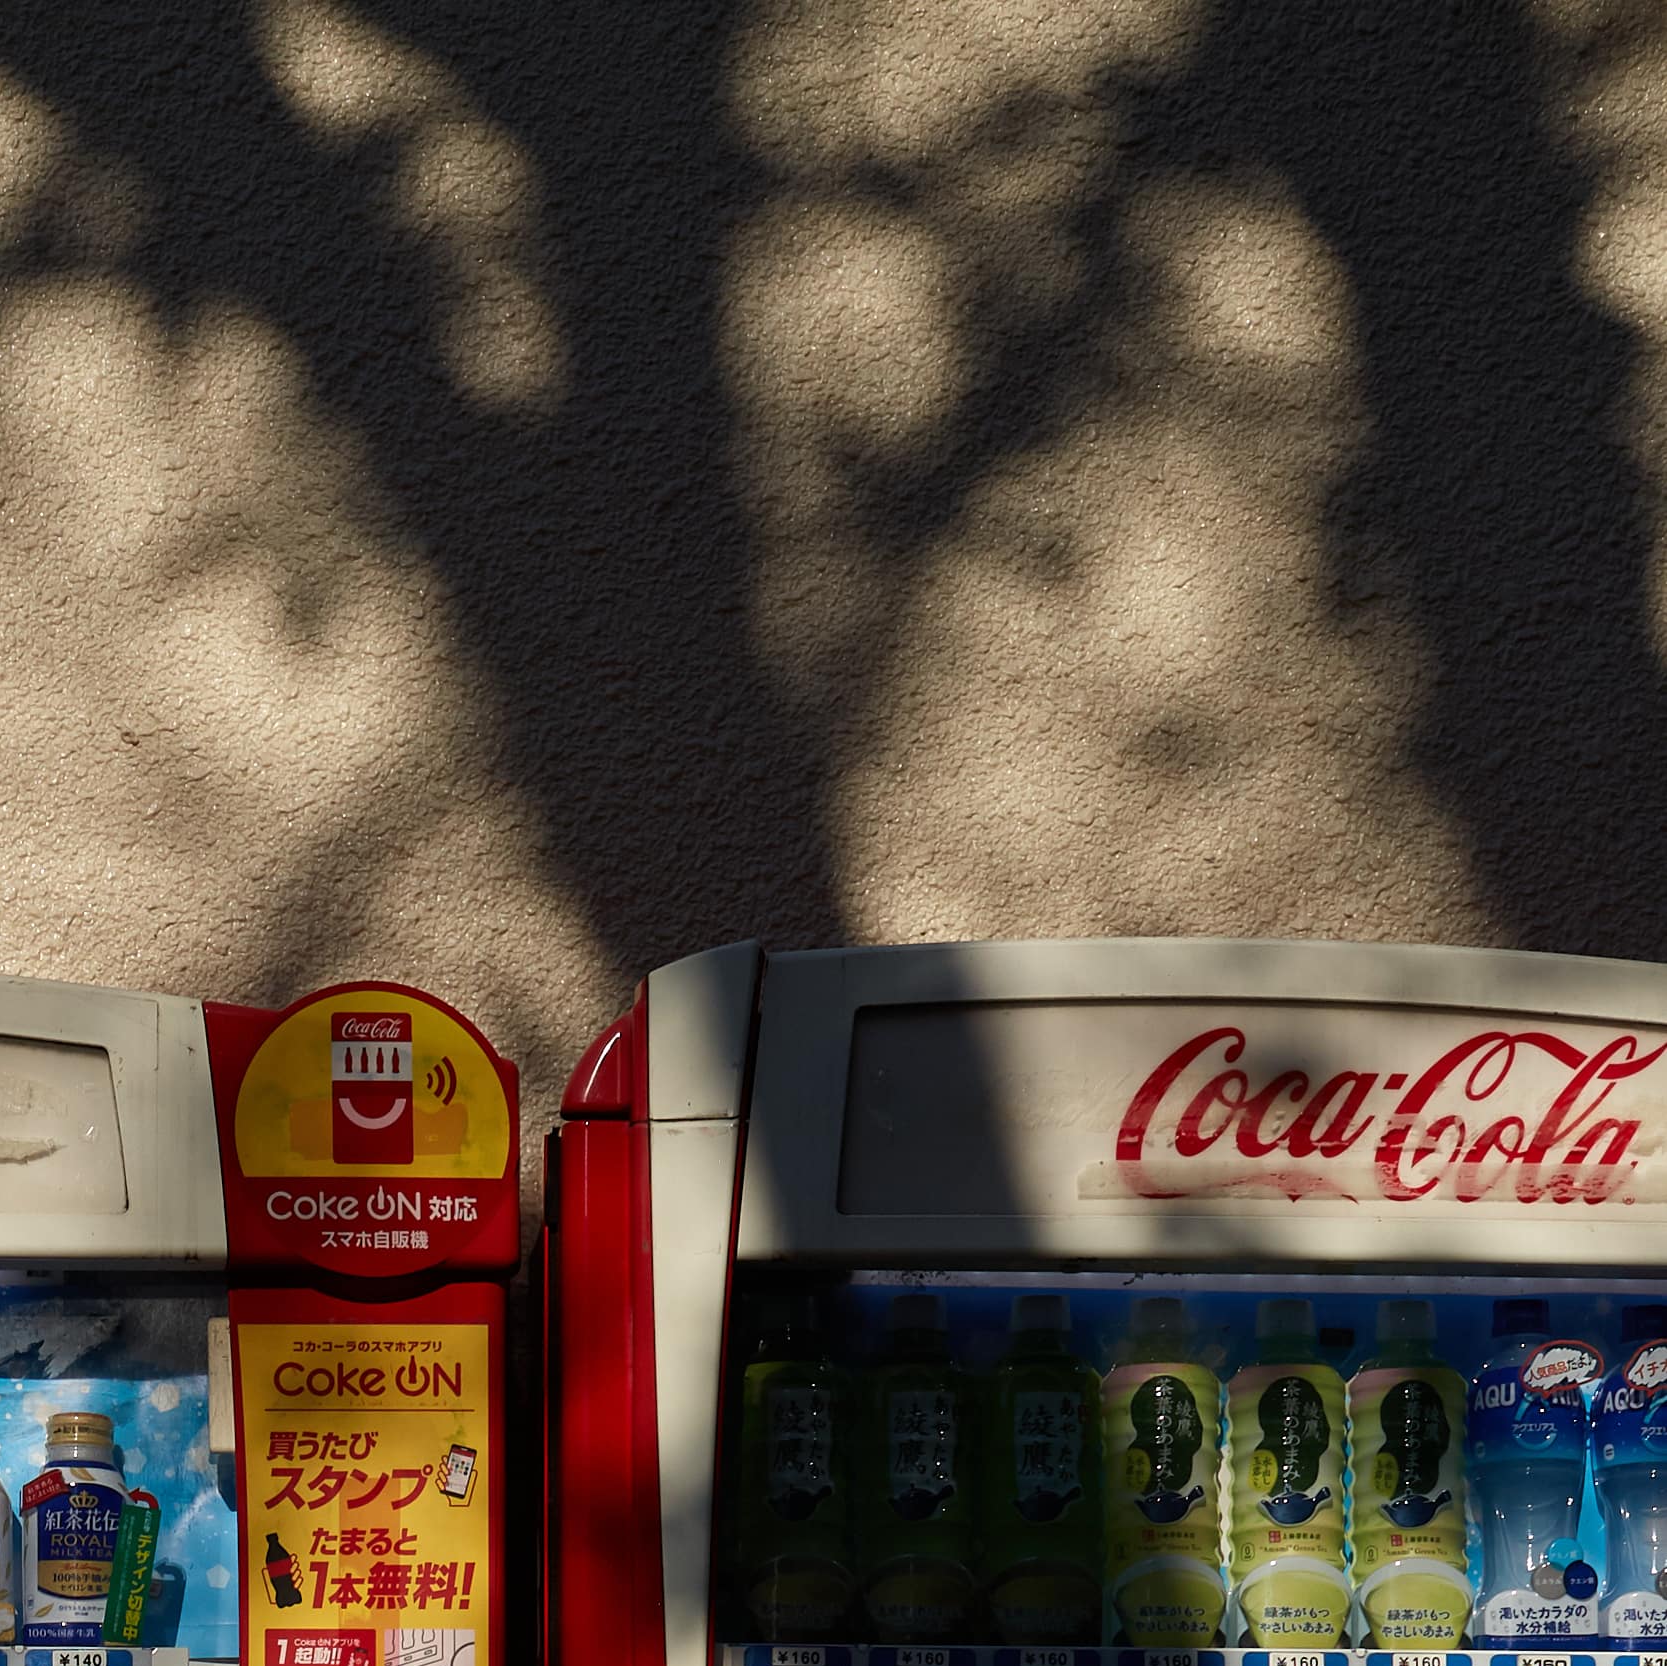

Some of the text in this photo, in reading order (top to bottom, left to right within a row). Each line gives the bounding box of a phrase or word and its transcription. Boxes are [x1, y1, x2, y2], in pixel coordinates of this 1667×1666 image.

[342, 1018, 403, 1039] Coca-Cola
[1116, 1027, 1667, 1206] Coca-Cola
[267, 1185, 478, 1222] Coke ON 対応
[321, 1230, 429, 1250] スマホ自販機
[273, 1355, 461, 1397] Coke ON
[266, 1431, 379, 1461] 買うたび
[264, 1464, 433, 1510] スタンプ
[50, 1534, 113, 1548] ROYAL
[309, 1527, 418, 1555] たまると
[309, 1561, 475, 1610] 1本無料!
[1264, 1607, 1330, 1621] 緑茶がもつ
[1516, 1621, 1572, 1635] 水分補給
[1259, 1622, 1335, 1637] やさしいあまみ
